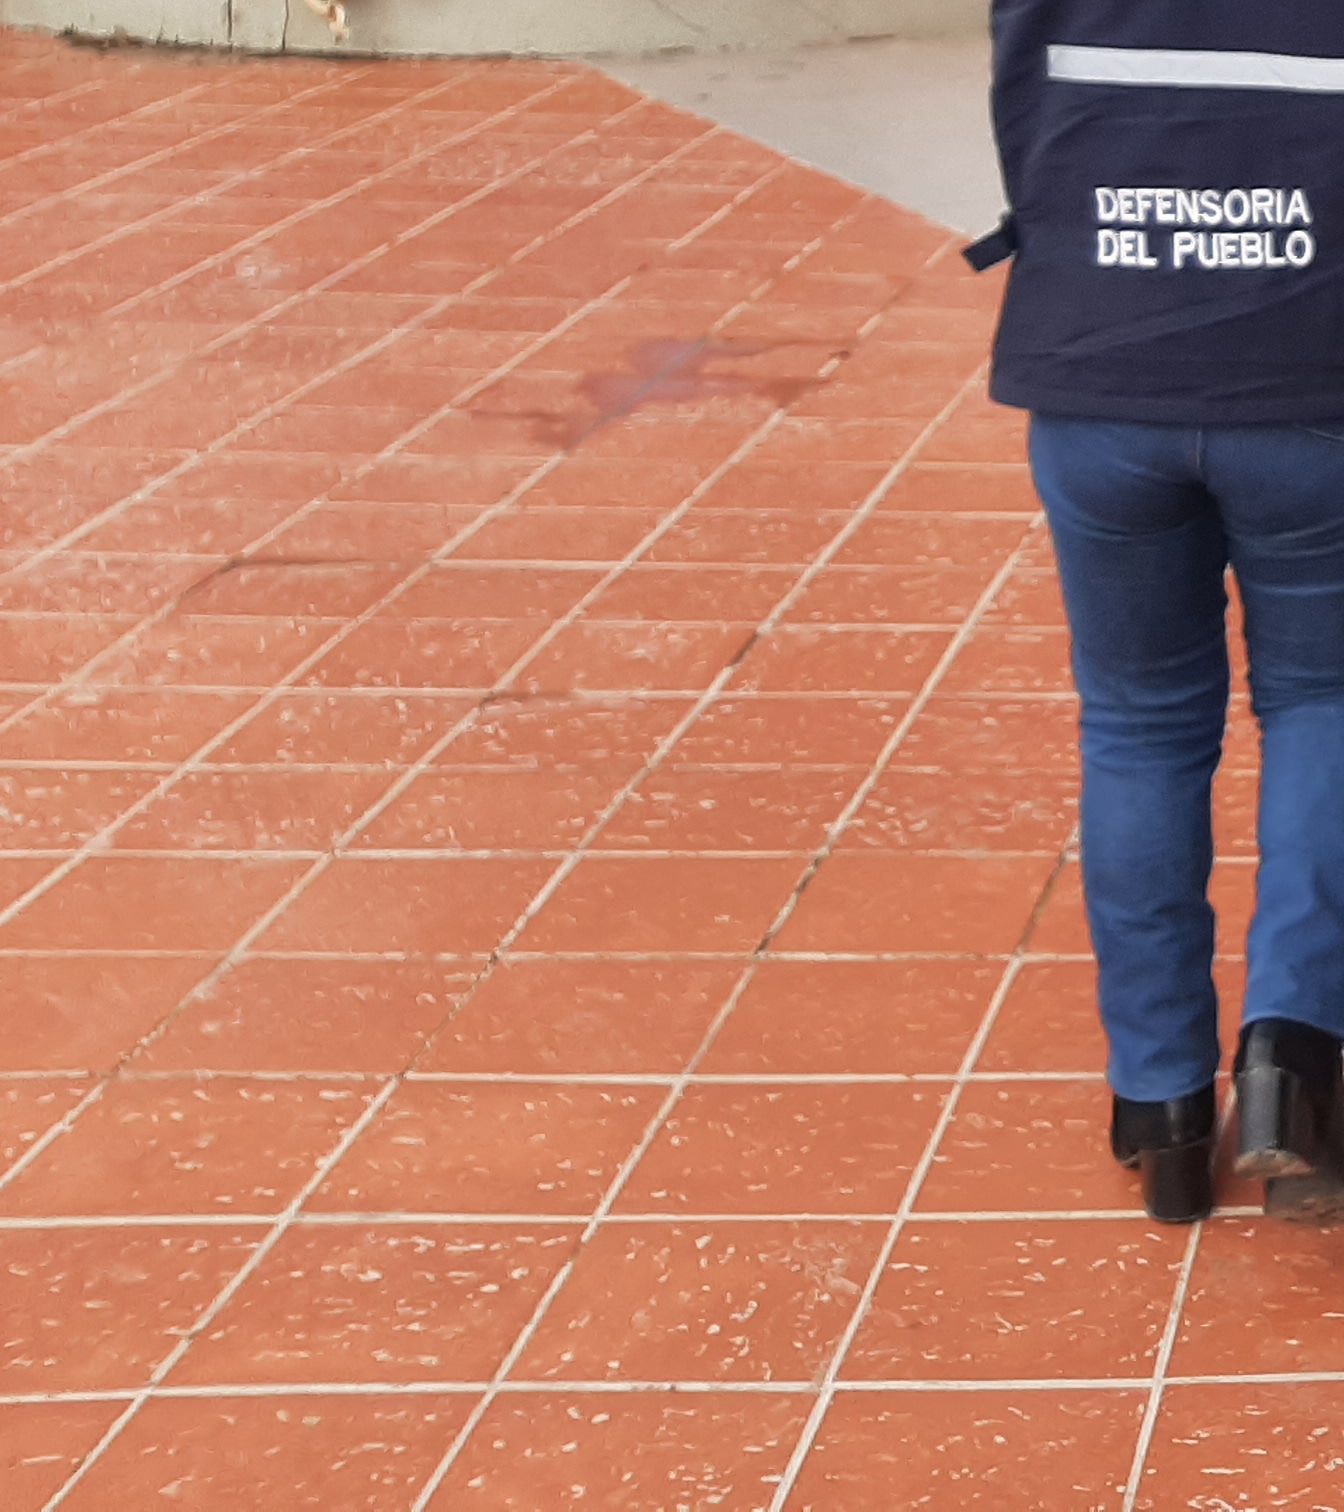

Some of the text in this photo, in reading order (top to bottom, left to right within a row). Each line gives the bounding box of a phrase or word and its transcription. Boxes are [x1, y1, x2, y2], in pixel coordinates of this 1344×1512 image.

[1094, 186, 1314, 226] DEFENSORIA
[1096, 228, 1316, 269] DEL PUEBLO
